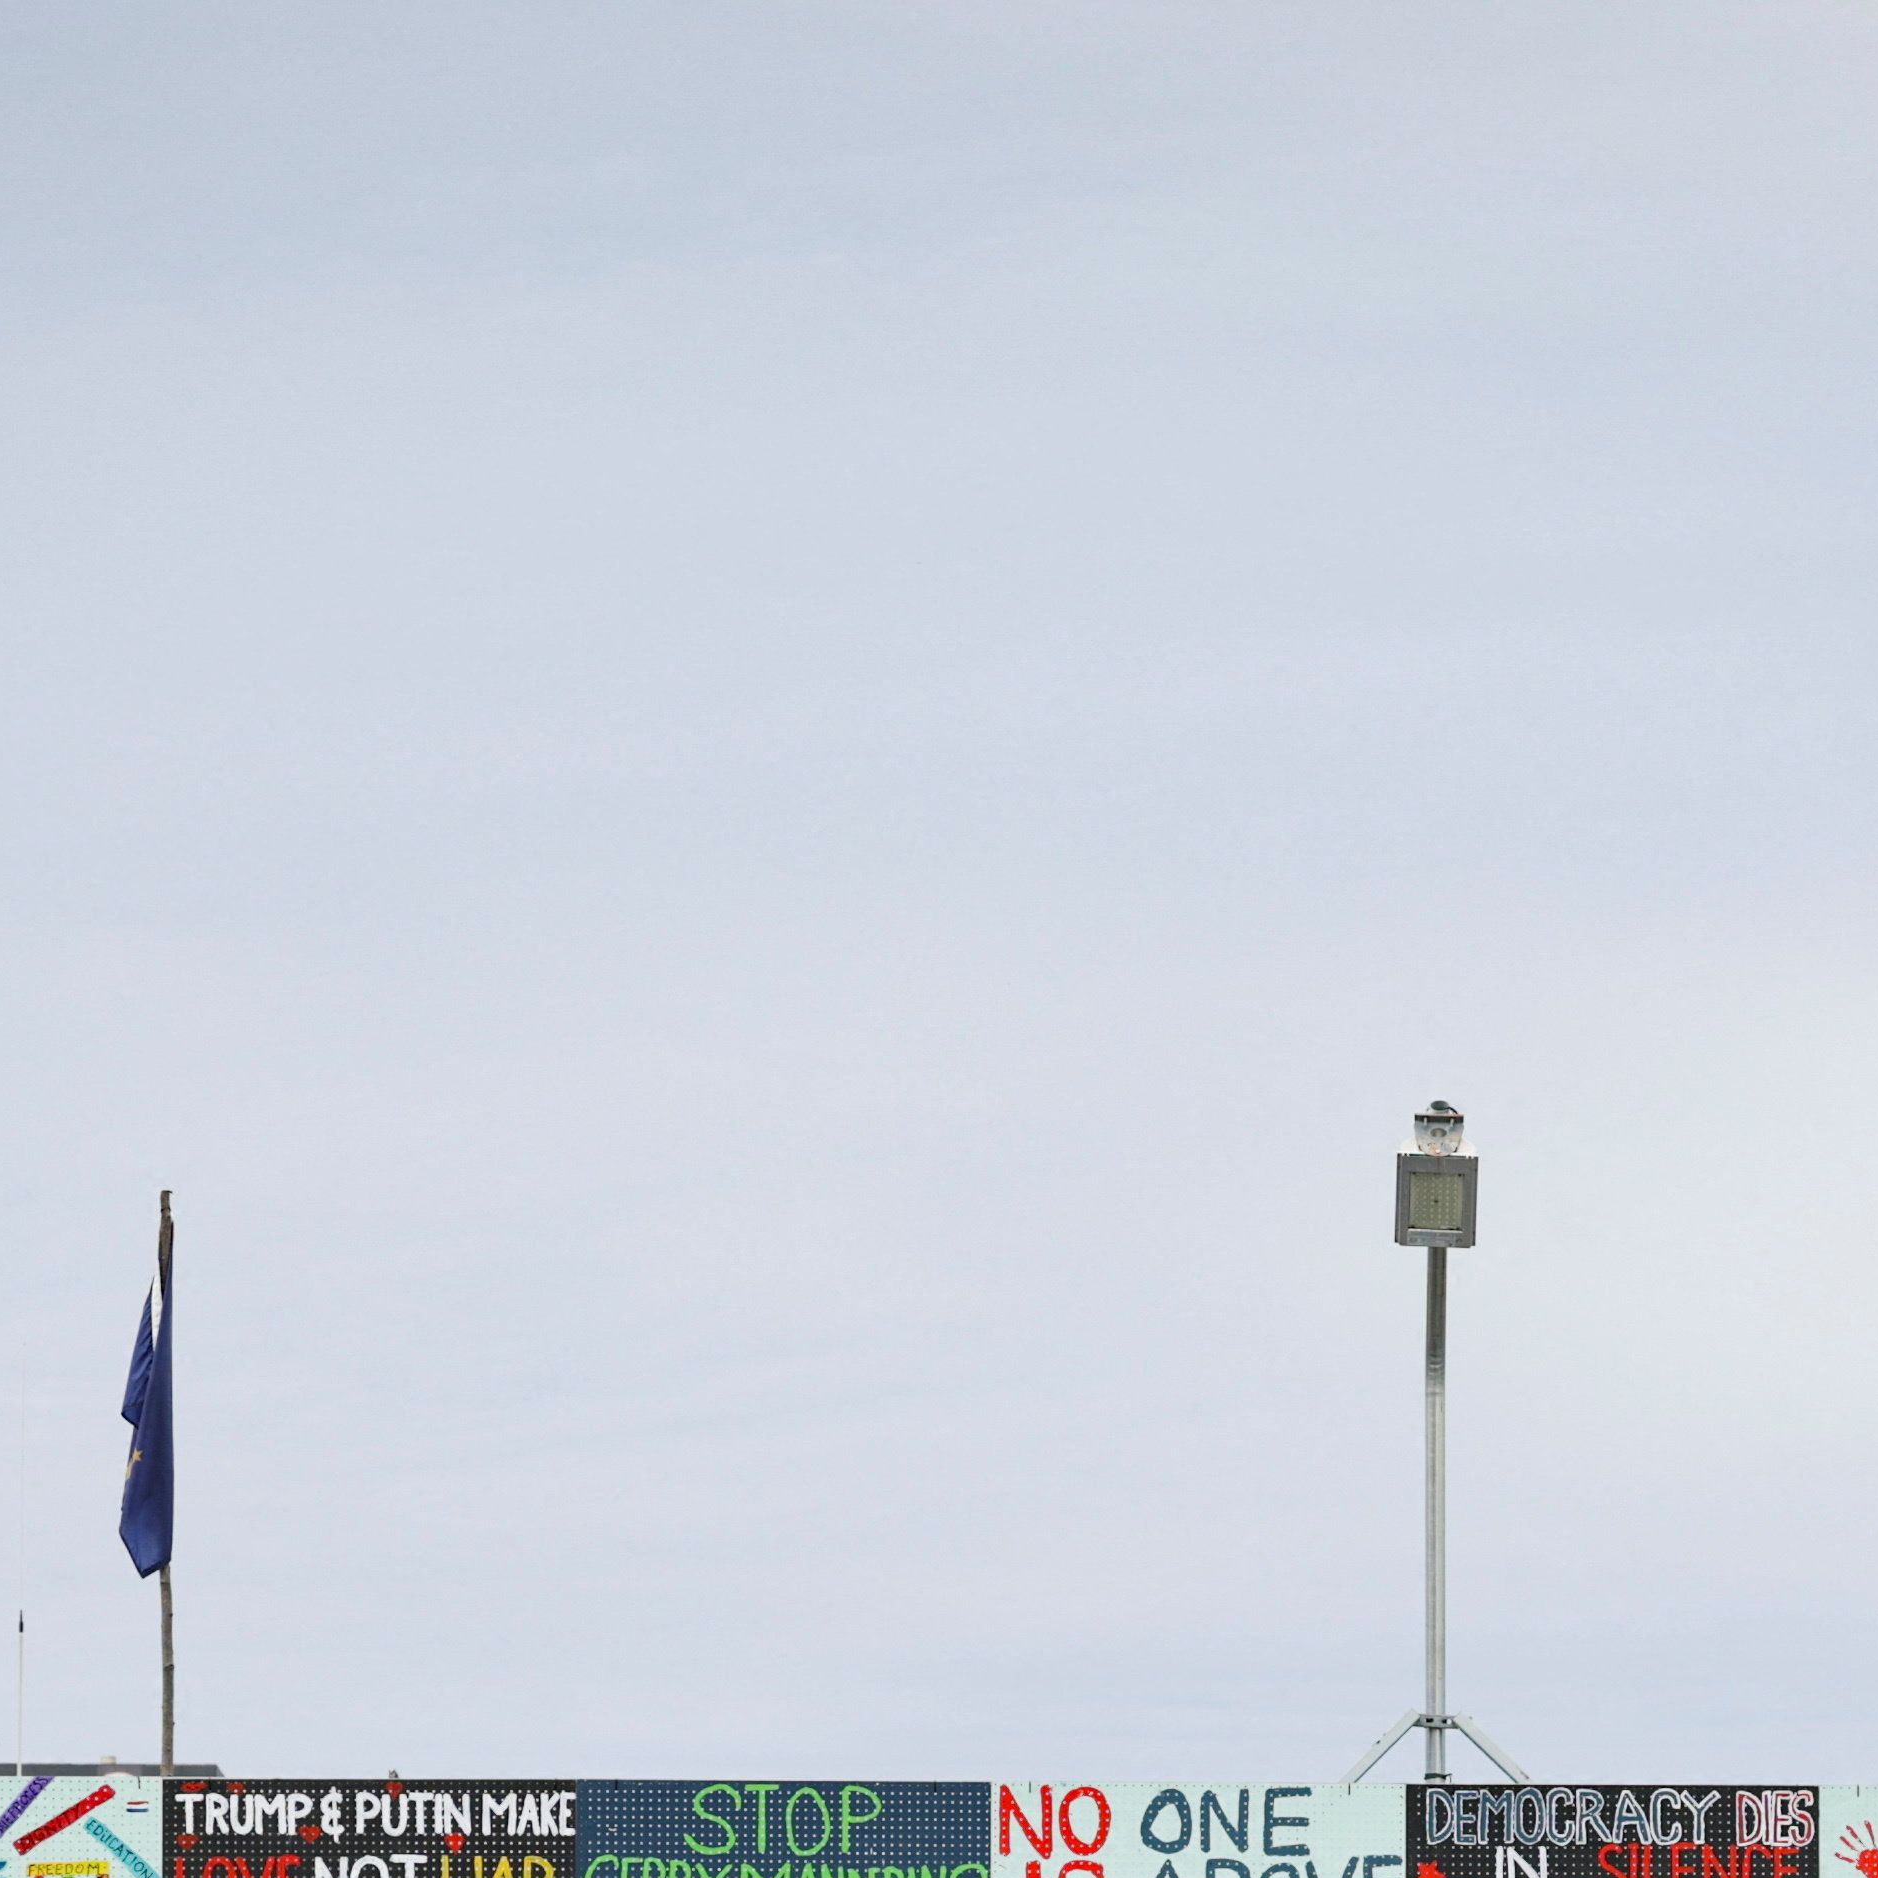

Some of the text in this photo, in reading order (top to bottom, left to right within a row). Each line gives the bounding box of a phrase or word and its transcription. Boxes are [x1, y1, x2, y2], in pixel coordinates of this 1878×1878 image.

[174, 1786, 576, 1843] TRUMP & PUTIN MAKE
[683, 1784, 883, 1856] STOP
[999, 1784, 1312, 1859] NO ONE
[1425, 1787, 1815, 1847] DEMOCRACY DIES
[28, 1863, 100, 1877] FREEDOM
